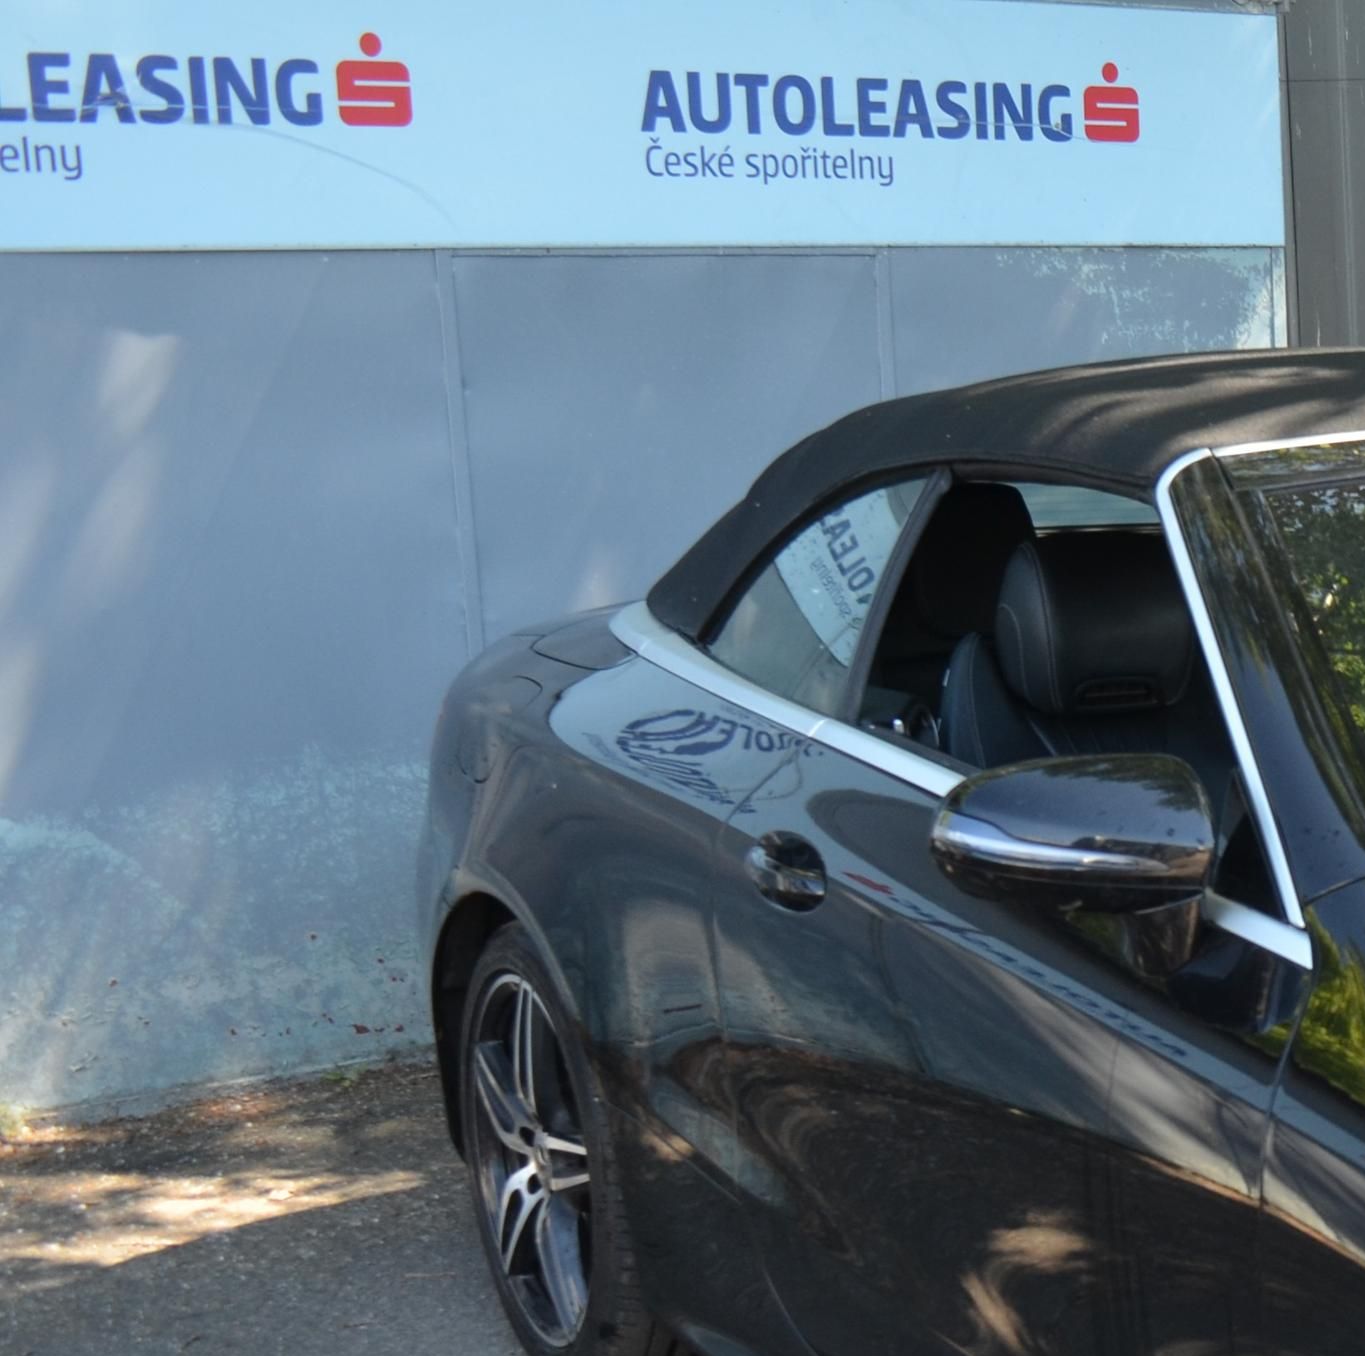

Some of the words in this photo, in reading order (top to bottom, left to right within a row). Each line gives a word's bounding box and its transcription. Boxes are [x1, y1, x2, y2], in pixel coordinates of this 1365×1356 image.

[640, 69, 1074, 143] AUTOLEASING
[645, 137, 734, 178] České
[745, 146, 894, 187] spořitelny
